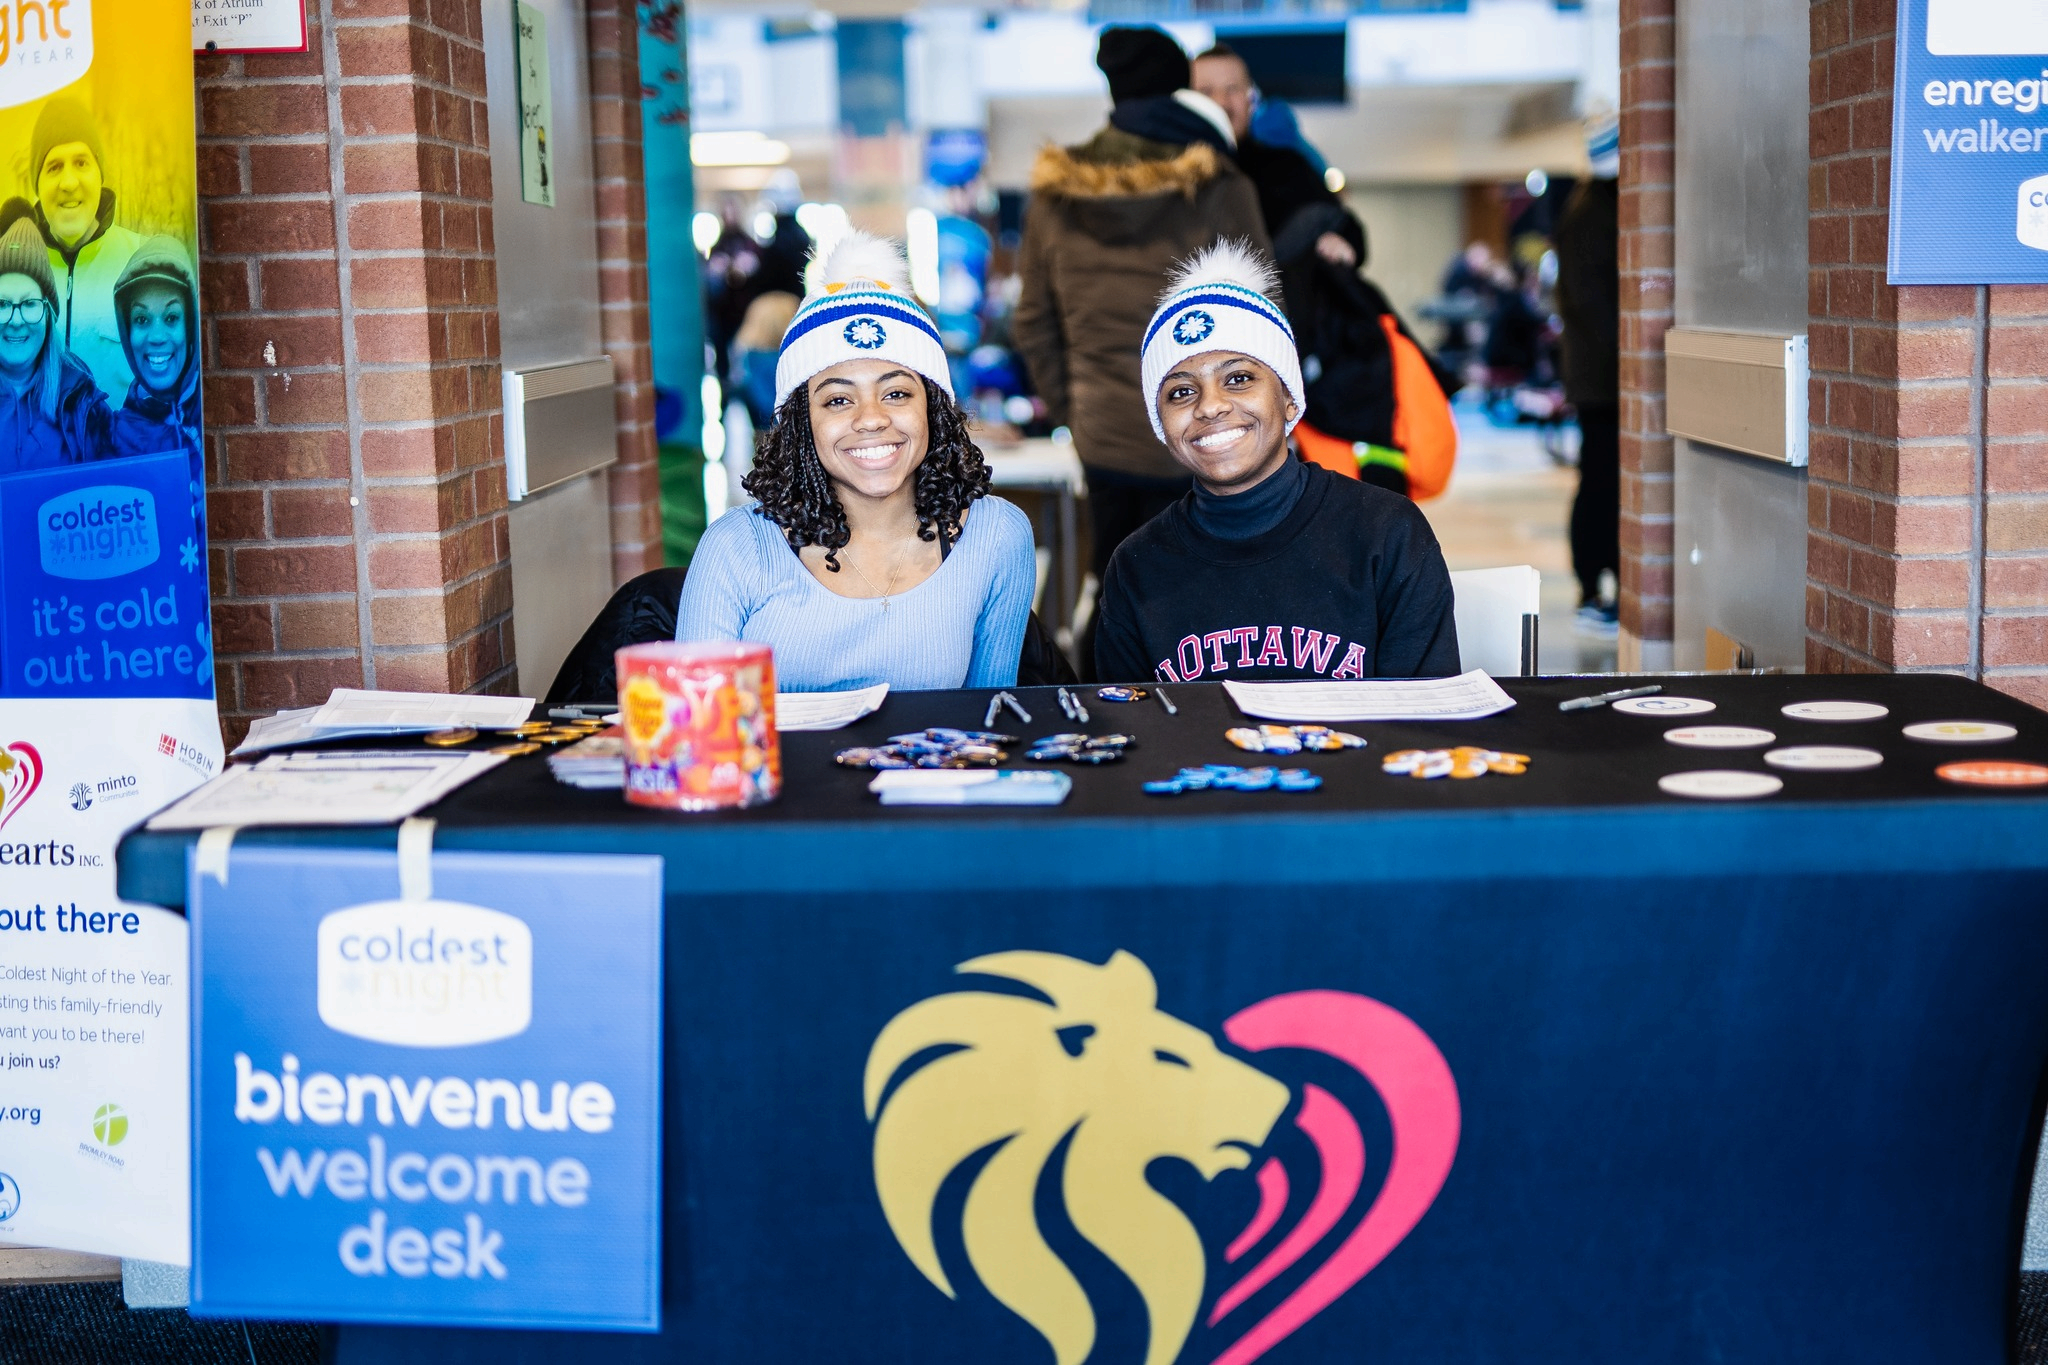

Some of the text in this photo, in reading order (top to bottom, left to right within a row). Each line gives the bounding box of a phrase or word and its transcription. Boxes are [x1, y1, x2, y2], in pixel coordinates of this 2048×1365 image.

[205, 0, 217, 9] of
[221, 0, 263, 9] Atrium
[204, 14, 228, 27] Exit
[18, 47, 74, 65] YEAR
[1923, 69, 2048, 113] enregi
[1922, 118, 2048, 153] walker
[48, 498, 146, 532] coldest
[68, 520, 149, 560] night
[33, 584, 179, 637] it's cold
[24, 639, 194, 687] out here
[180, 742, 214, 772] HOBIN
[97, 775, 137, 793] minto
[99, 789, 139, 803] Communities
[0, 840, 104, 867] earts INC.
[0, 902, 140, 934] out there
[339, 925, 508, 966] coldest
[52, 967, 87, 985] Night
[92, 969, 107, 983] of
[111, 969, 136, 984] the
[141, 970, 173, 986] Year.
[33, 995, 57, 1011] this
[61, 996, 163, 1018] family-friendly
[32, 1028, 57, 1042] you
[62, 1027, 76, 1041] to
[80, 1027, 98, 1042] be
[102, 1028, 145, 1044] there!
[8, 1052, 34, 1070] join
[39, 1055, 61, 1069] us?
[233, 1051, 616, 1133] bienvenue
[257, 1134, 591, 1207] welcome
[338, 1209, 507, 1280] desk
